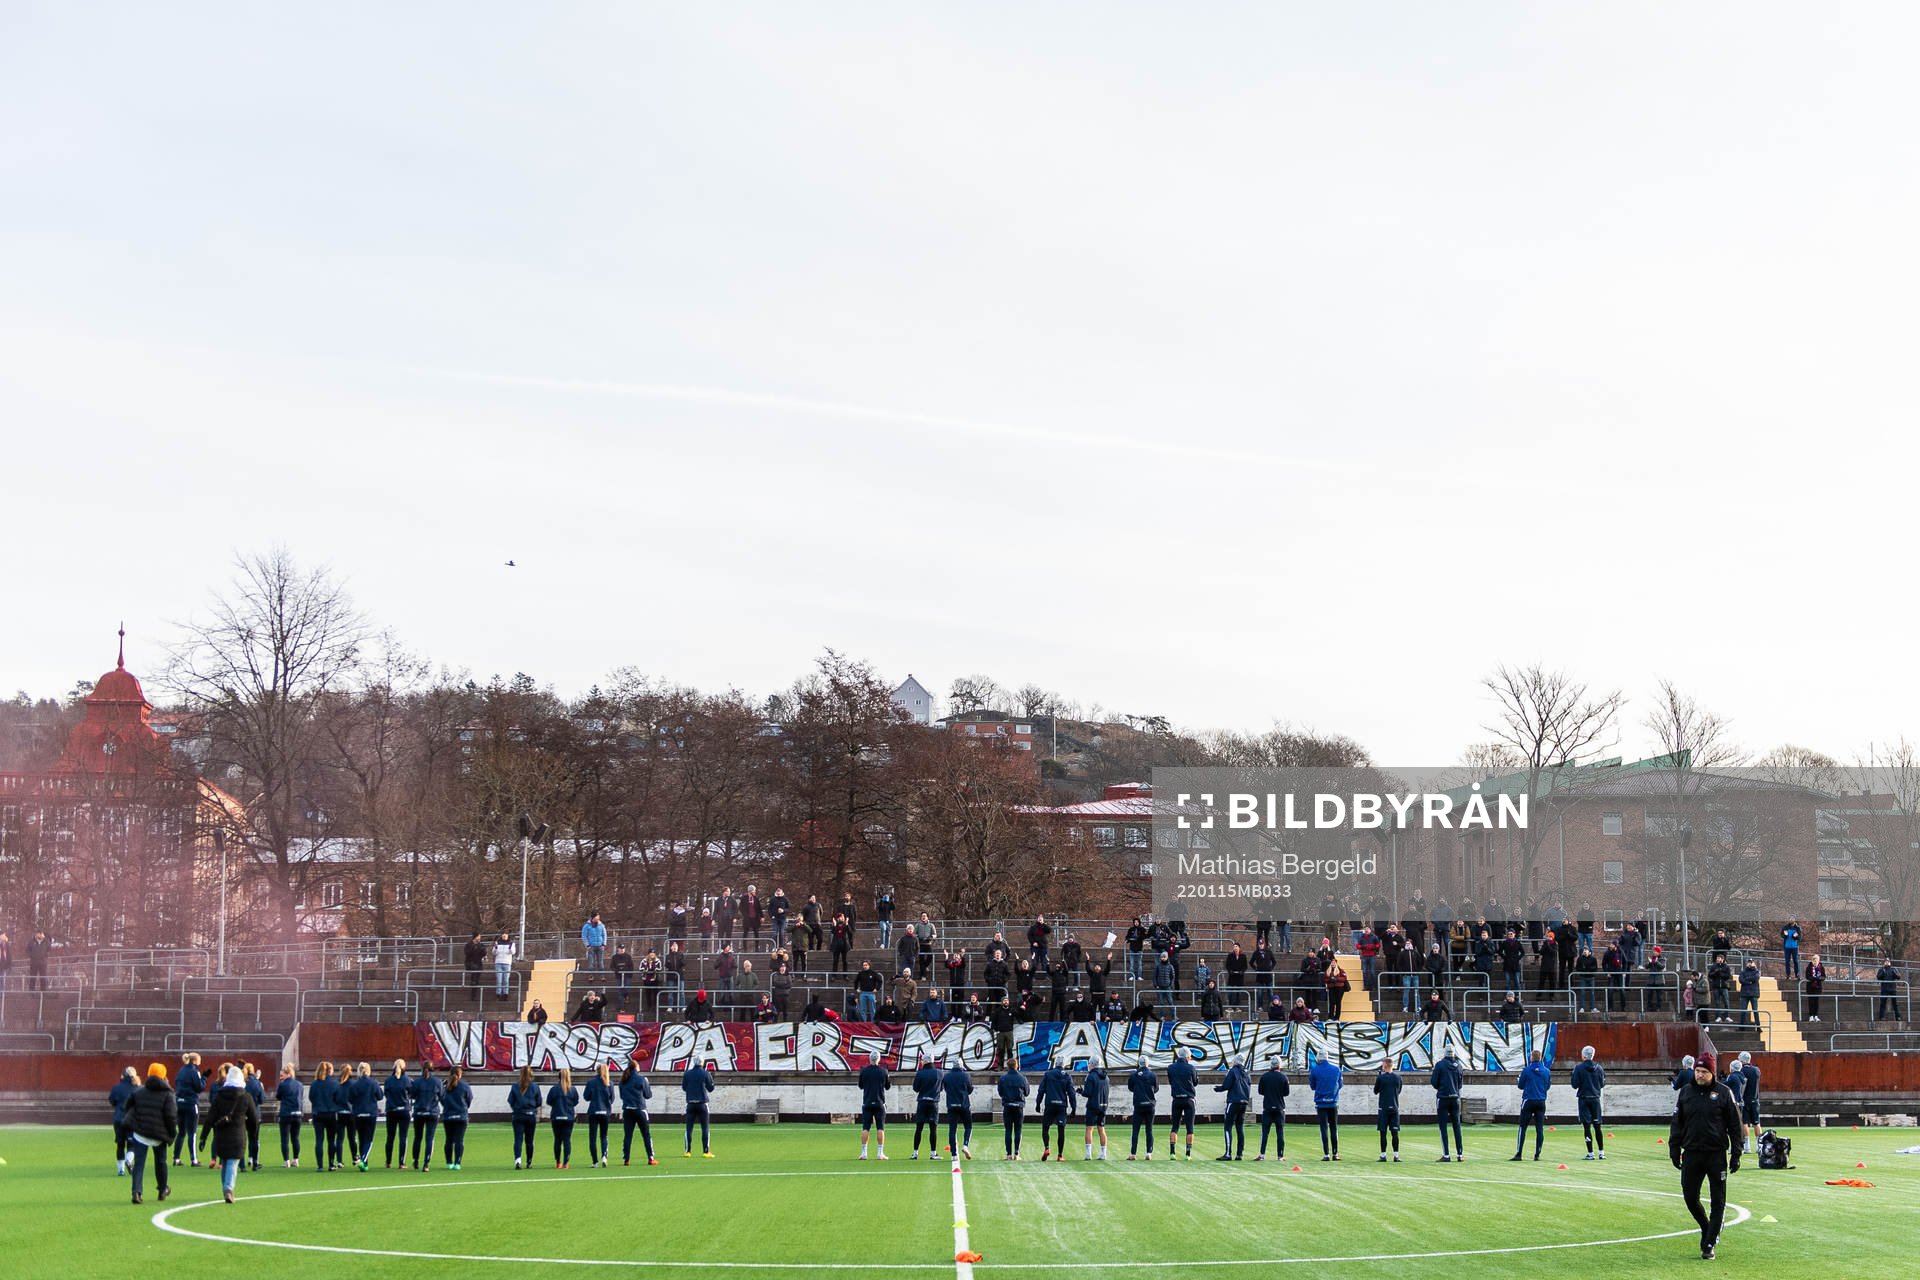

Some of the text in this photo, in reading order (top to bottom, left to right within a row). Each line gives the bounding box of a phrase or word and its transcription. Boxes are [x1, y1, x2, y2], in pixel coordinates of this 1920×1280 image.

[432, 1021, 487, 1069] VI
[500, 1022, 640, 1070] TROR
[652, 1022, 736, 1071] PÅ
[754, 1022, 849, 1071] ER
